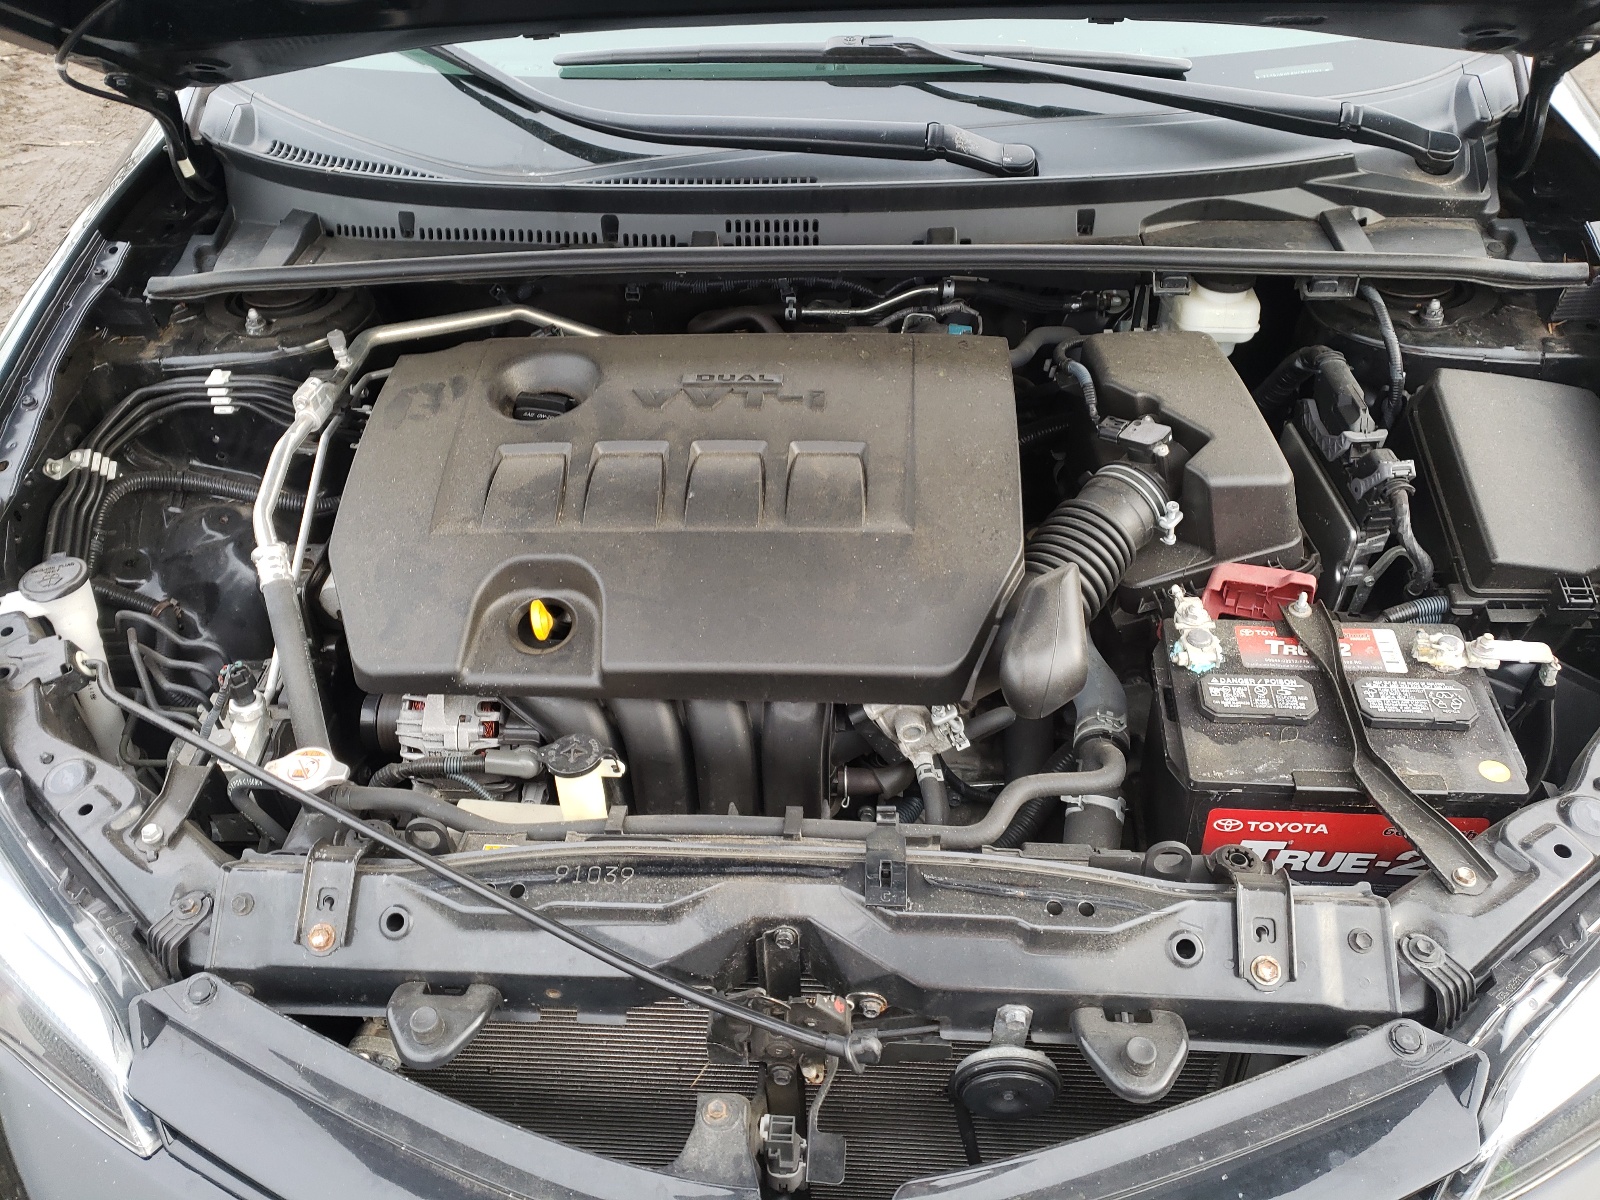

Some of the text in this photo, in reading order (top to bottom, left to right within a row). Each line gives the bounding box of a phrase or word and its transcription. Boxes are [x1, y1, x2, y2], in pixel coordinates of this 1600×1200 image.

[696, 374, 774, 382] DUAL
[1255, 629, 1278, 637] TOY
[1220, 677, 1256, 686] DANGER
[1264, 678, 1298, 686] POISON
[1247, 821, 1329, 835] TOYOTA
[555, 865, 635, 885] 91039
